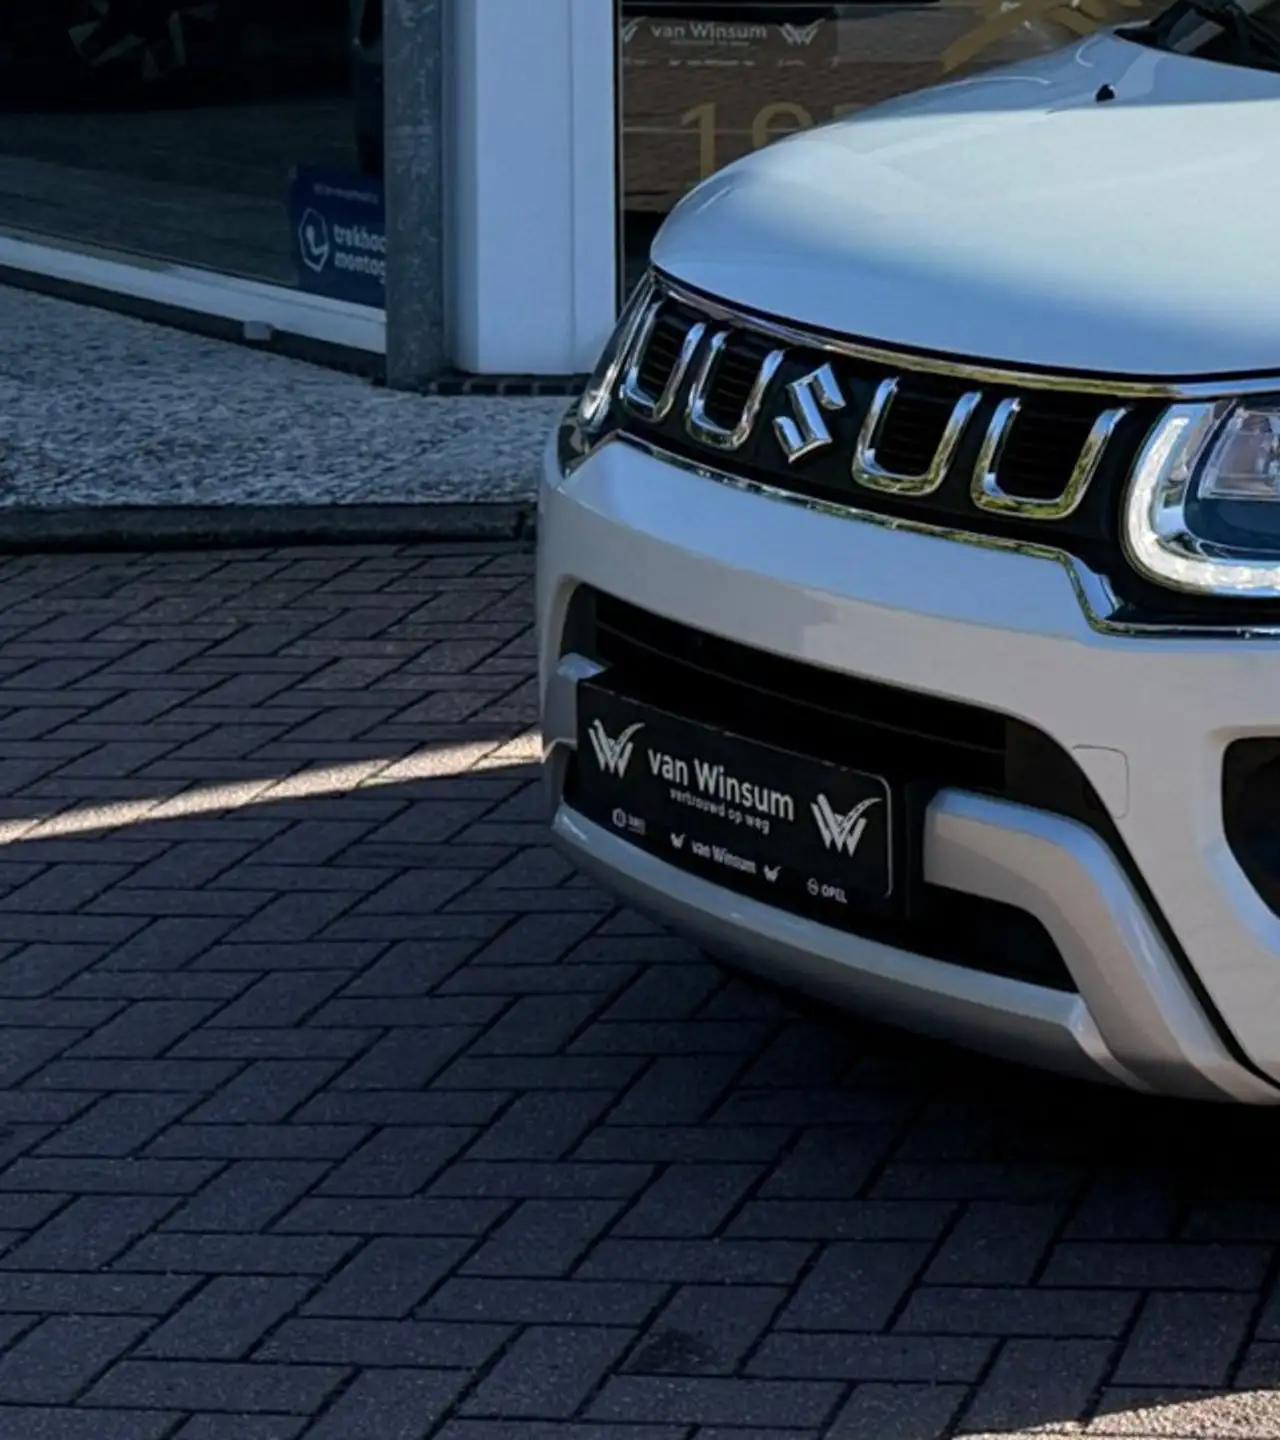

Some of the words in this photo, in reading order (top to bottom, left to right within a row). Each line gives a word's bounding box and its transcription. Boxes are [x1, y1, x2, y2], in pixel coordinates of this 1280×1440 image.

[689, 20, 768, 41] Winsum
[647, 748, 689, 786] van
[693, 758, 795, 821] Winsum
[727, 807, 742, 826] op
[745, 813, 770, 835] weg
